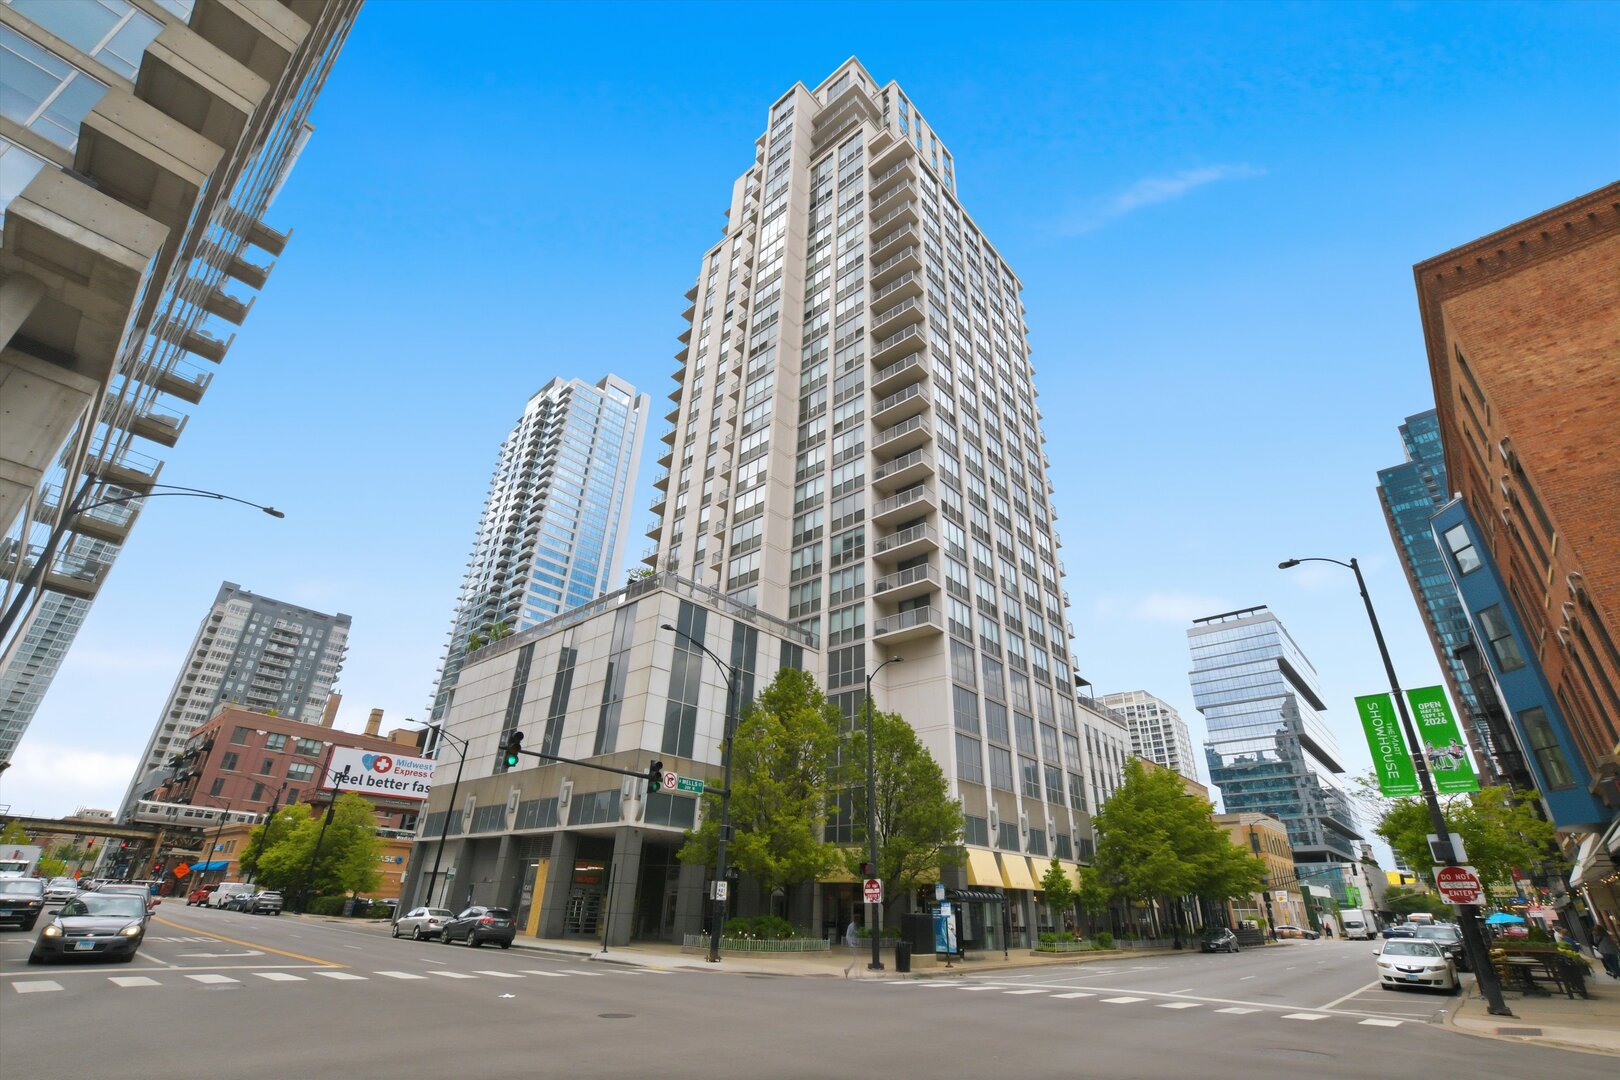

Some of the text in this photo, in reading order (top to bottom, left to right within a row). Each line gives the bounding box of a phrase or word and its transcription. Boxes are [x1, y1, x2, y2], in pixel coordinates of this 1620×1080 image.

[1418, 701, 1441, 710] OPEN
[1424, 717, 1448, 726] 2026
[1367, 702, 1400, 779] SHOWHOUSE
[396, 759, 433, 771] Midwest
[394, 767, 428, 778] Express
[366, 775, 410, 791] better
